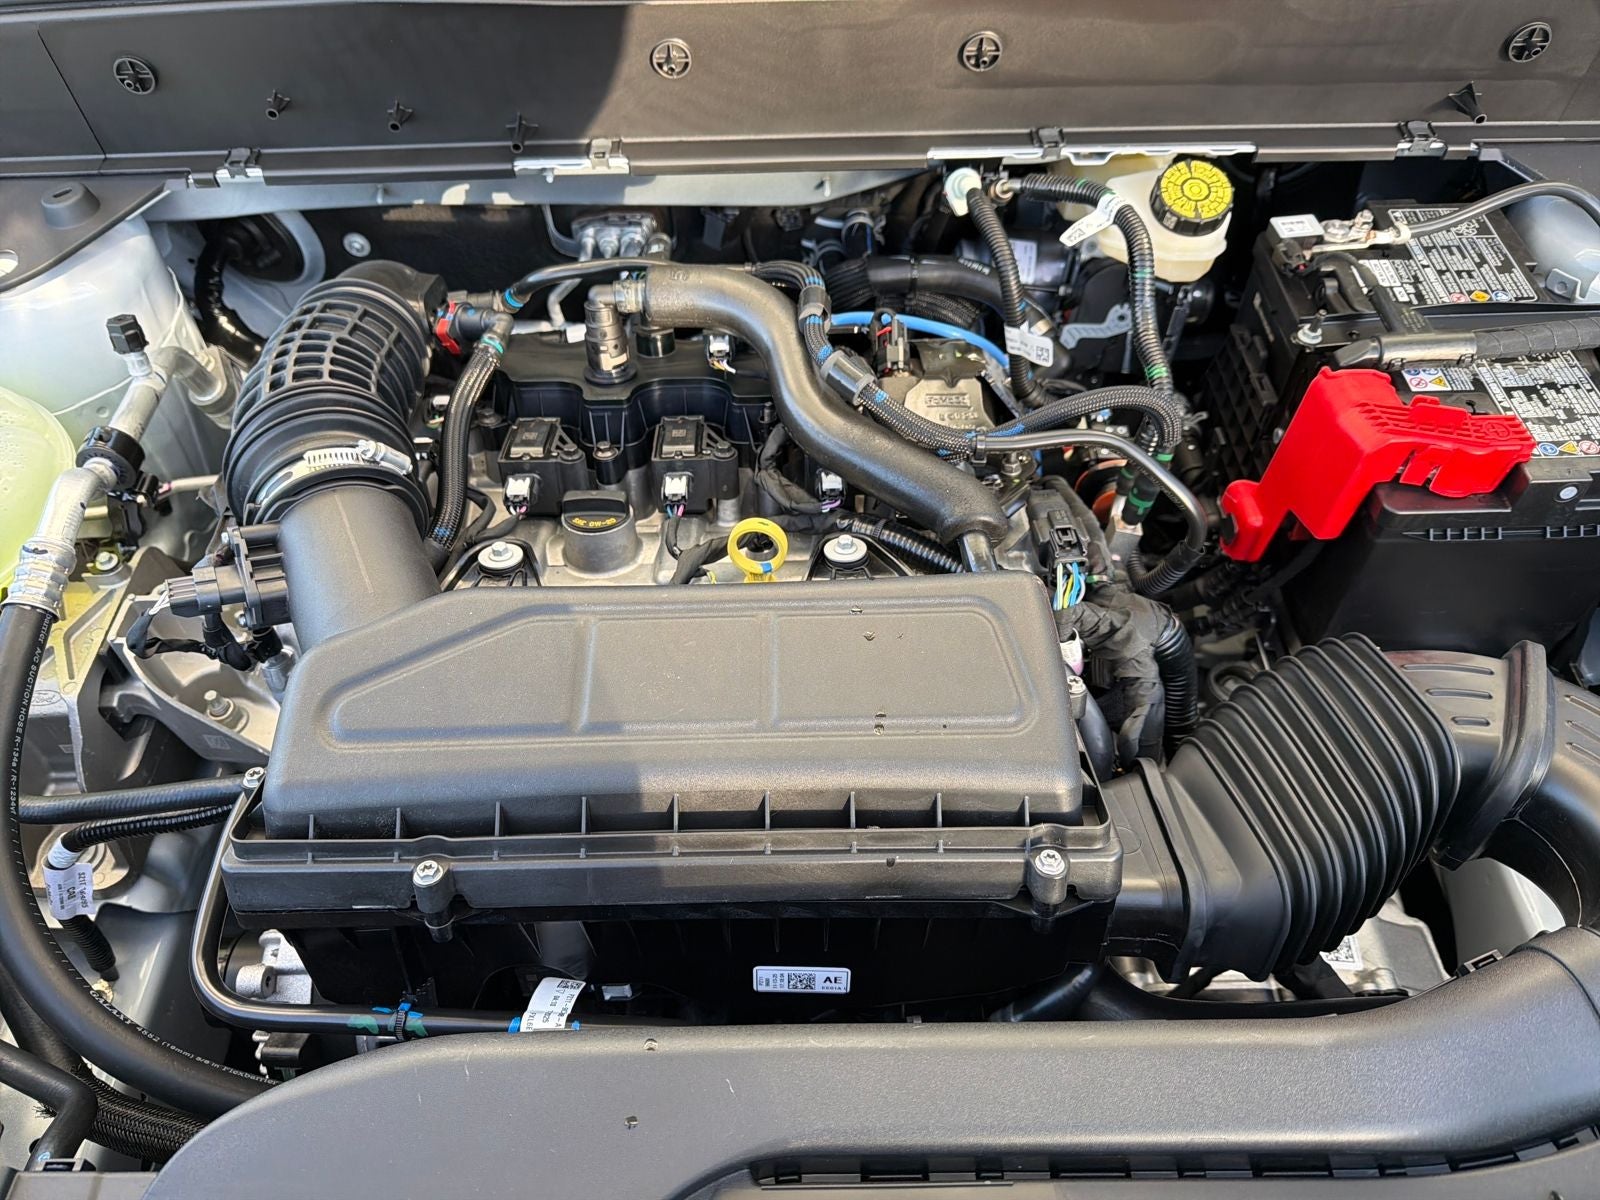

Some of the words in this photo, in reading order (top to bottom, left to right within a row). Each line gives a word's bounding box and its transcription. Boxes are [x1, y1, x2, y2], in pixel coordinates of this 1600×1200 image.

[22, 664, 37, 708] SUCTION
[16, 707, 27, 734] HOSE
[823, 976, 843, 984] AE
[89, 990, 133, 1025] GALAXY
